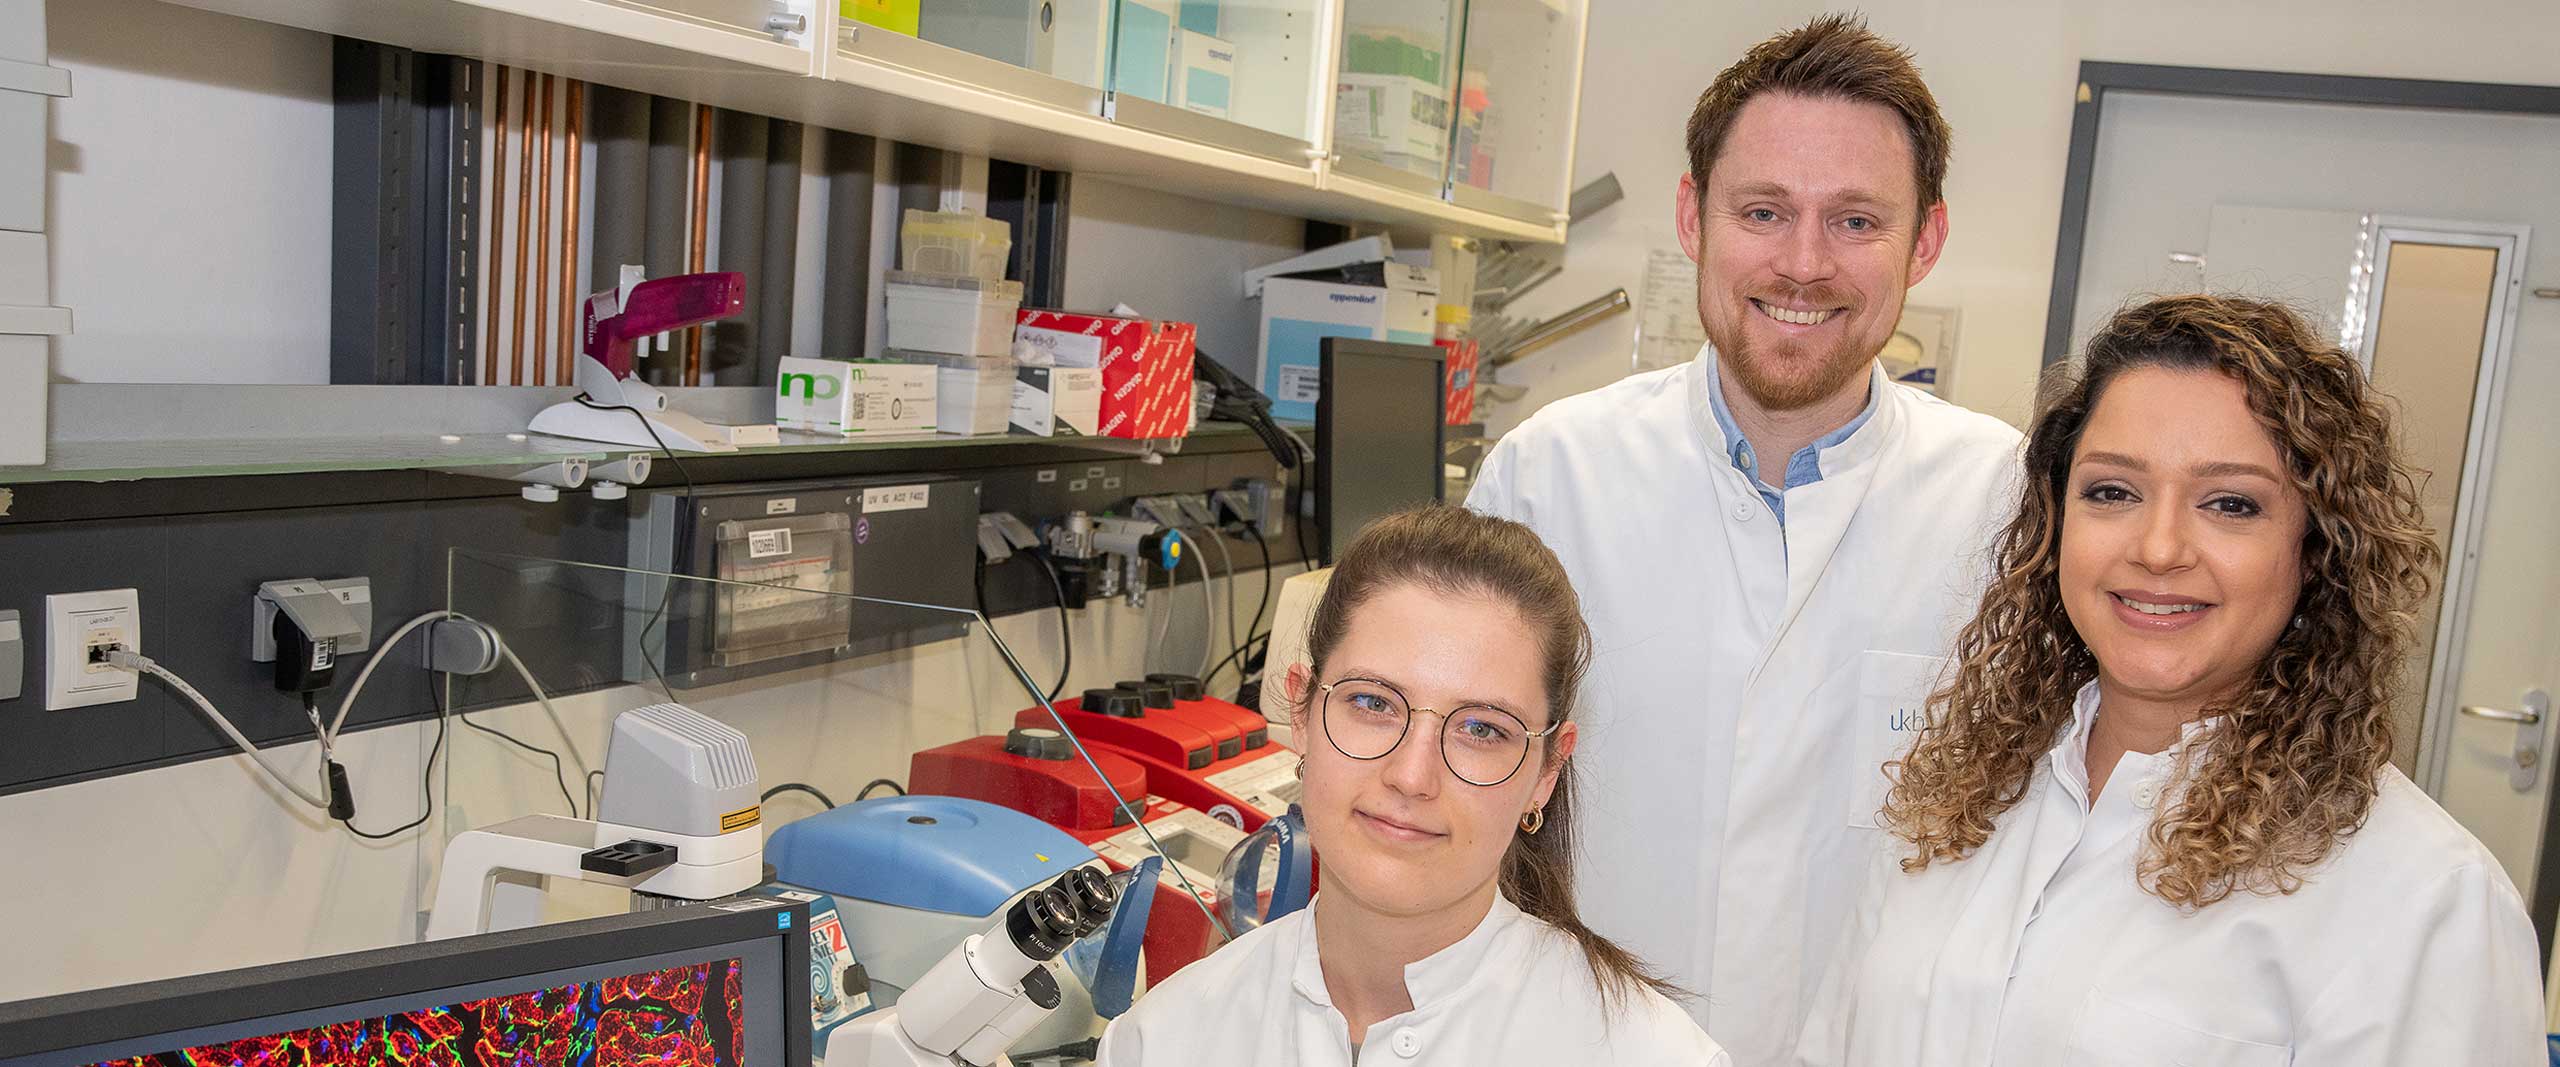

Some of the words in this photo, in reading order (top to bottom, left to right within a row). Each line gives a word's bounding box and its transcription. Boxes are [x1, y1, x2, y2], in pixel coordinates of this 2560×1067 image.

[1113, 372, 1143, 401] QIAGEN
[1890, 708, 1925, 732] ukb
[826, 922, 847, 953] 2
